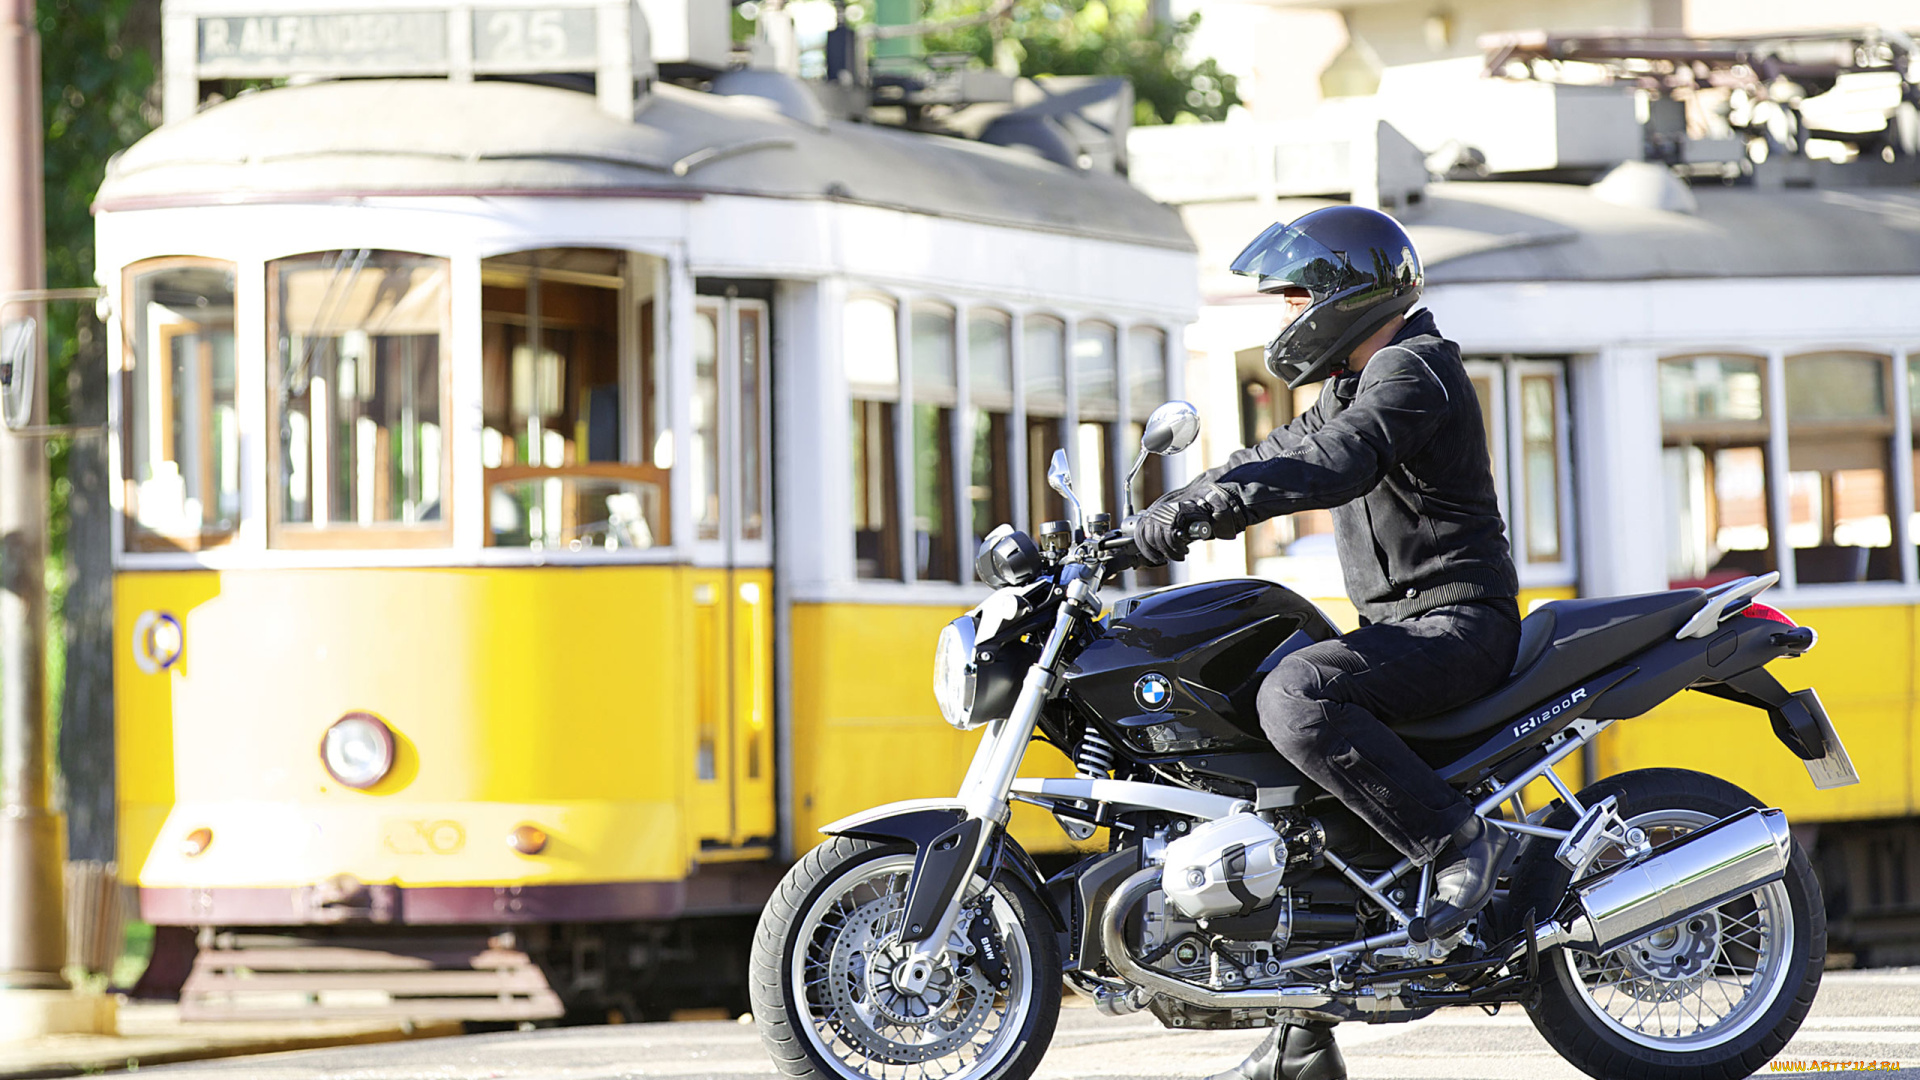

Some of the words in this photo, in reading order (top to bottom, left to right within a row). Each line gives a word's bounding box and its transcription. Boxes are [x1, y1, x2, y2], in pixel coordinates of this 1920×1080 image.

[204, 17, 236, 55] R.
[238, 14, 417, 54] ALFANDEG
[487, 9, 567, 60] 25
[1138, 675, 1168, 689] BMW
[980, 936, 996, 960] BMW
